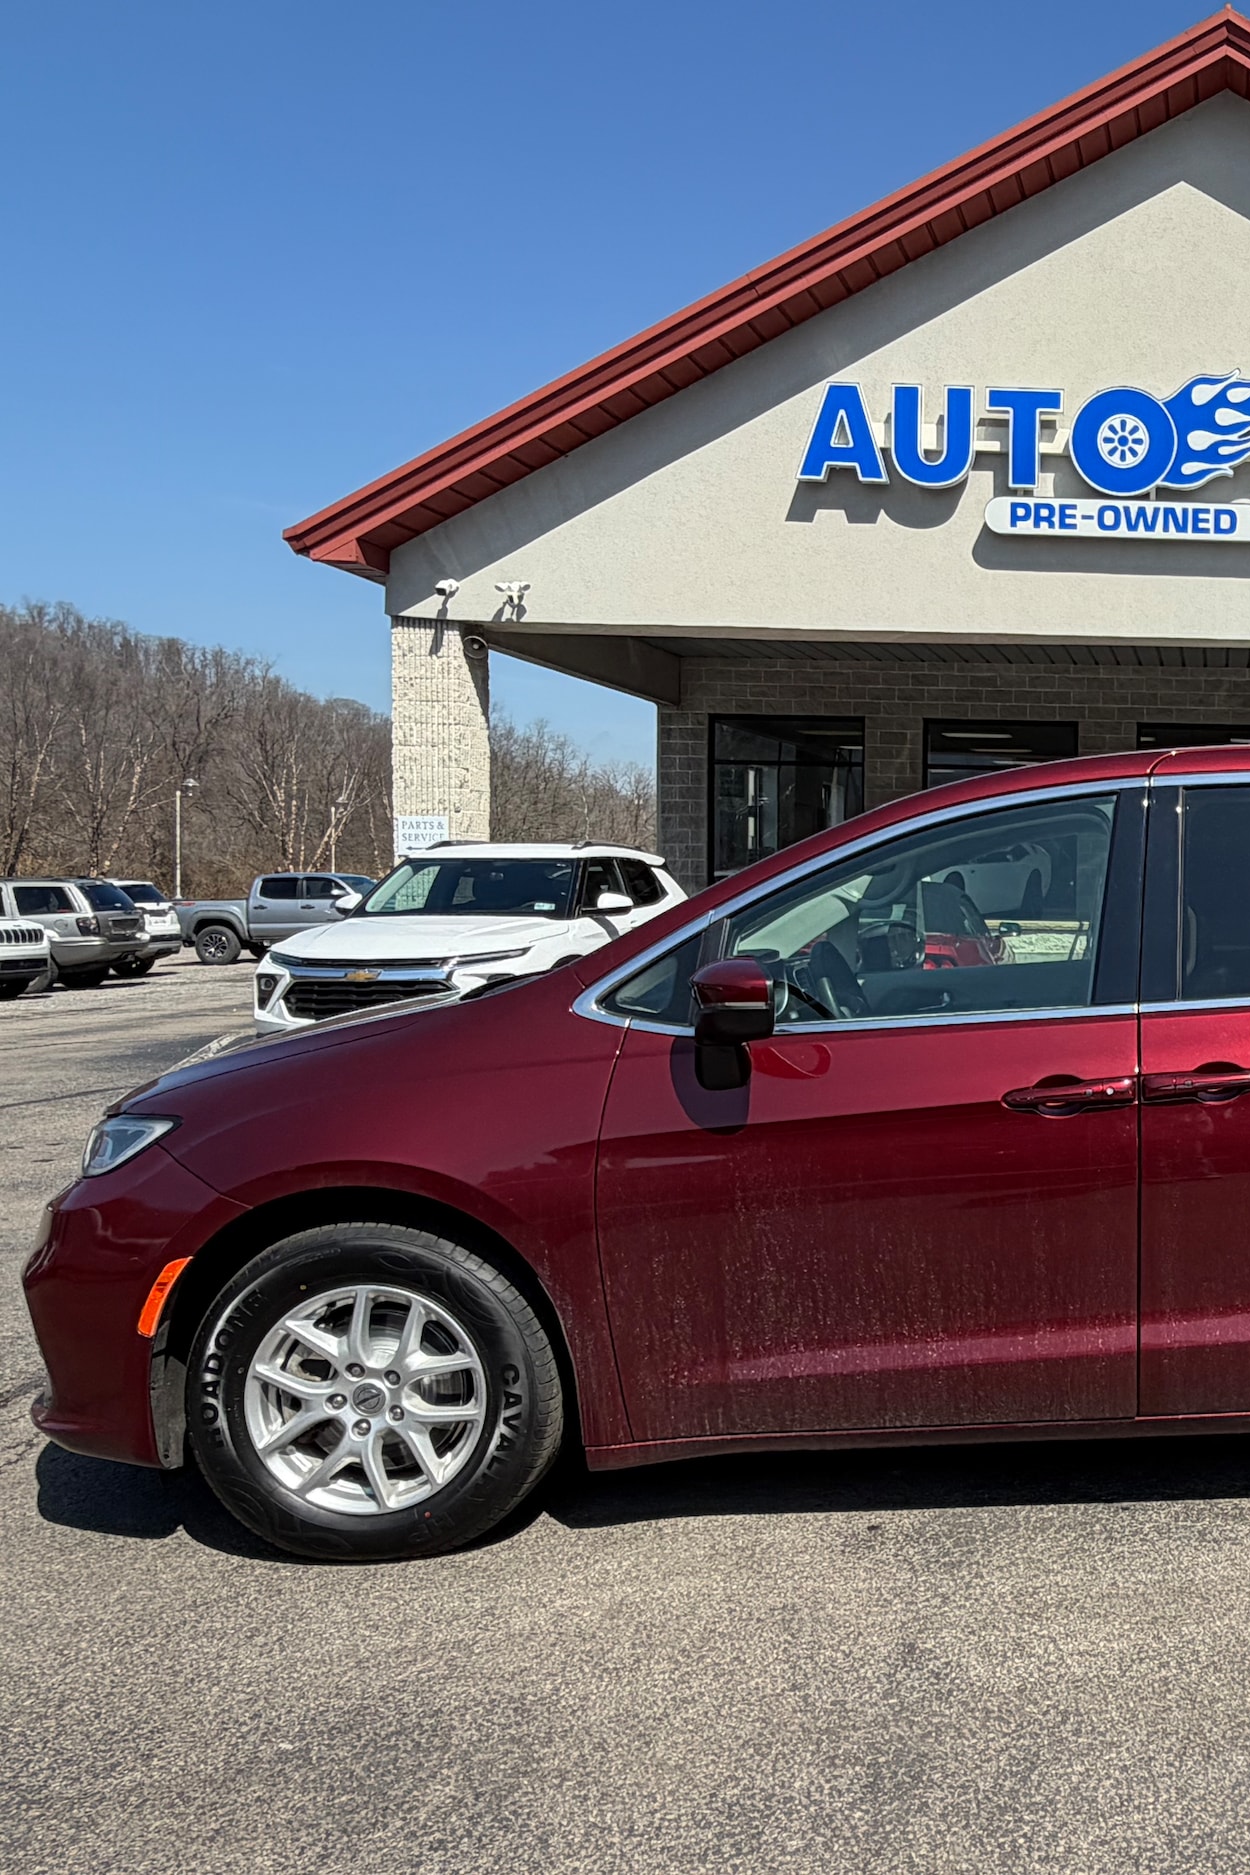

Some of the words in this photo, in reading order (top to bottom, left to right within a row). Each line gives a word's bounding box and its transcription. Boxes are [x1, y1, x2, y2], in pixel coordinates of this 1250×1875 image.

[796, 381, 1178, 497] AUTO
[1009, 501, 1237, 535] PRE-OWNED
[401, 820, 435, 830] PARTS
[436, 820, 445, 830] &
